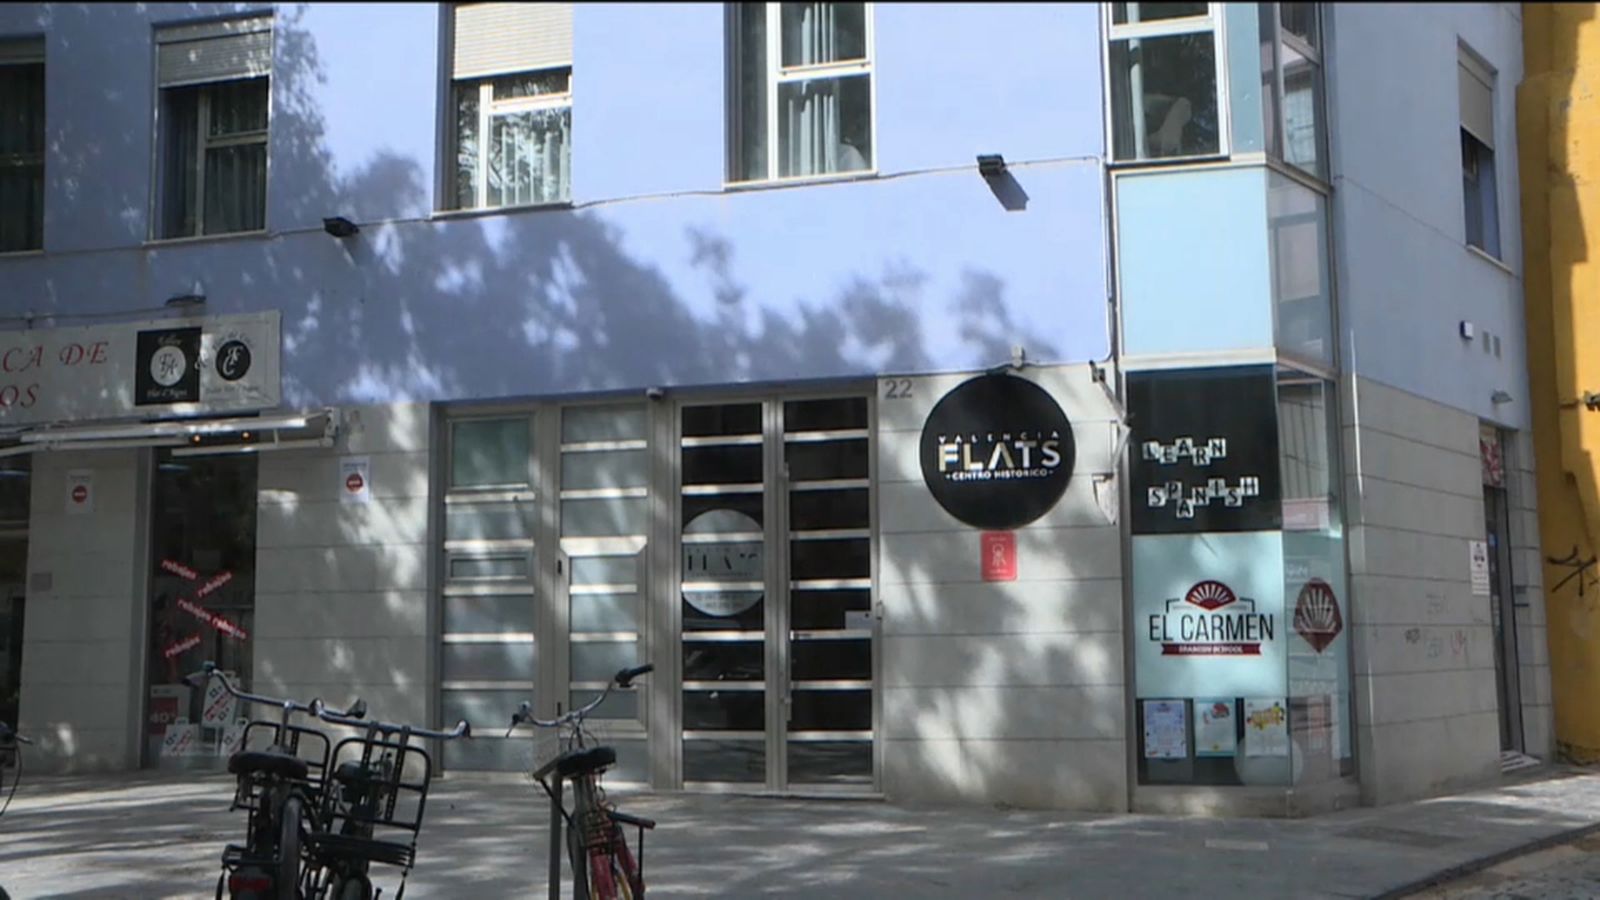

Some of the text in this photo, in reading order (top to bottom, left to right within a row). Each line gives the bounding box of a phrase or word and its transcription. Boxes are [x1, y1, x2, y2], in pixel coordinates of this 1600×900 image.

[59, 341, 109, 365] DE
[884, 379, 912, 399] 22
[938, 431, 1059, 443] VALENCIA
[939, 441, 1061, 472] FLATS
[1143, 439, 1226, 465] LEARN
[952, 470, 992, 481] CENTRO
[1148, 478, 1259, 518] SPANISH
[1149, 614, 1274, 641] EL CARMEN
